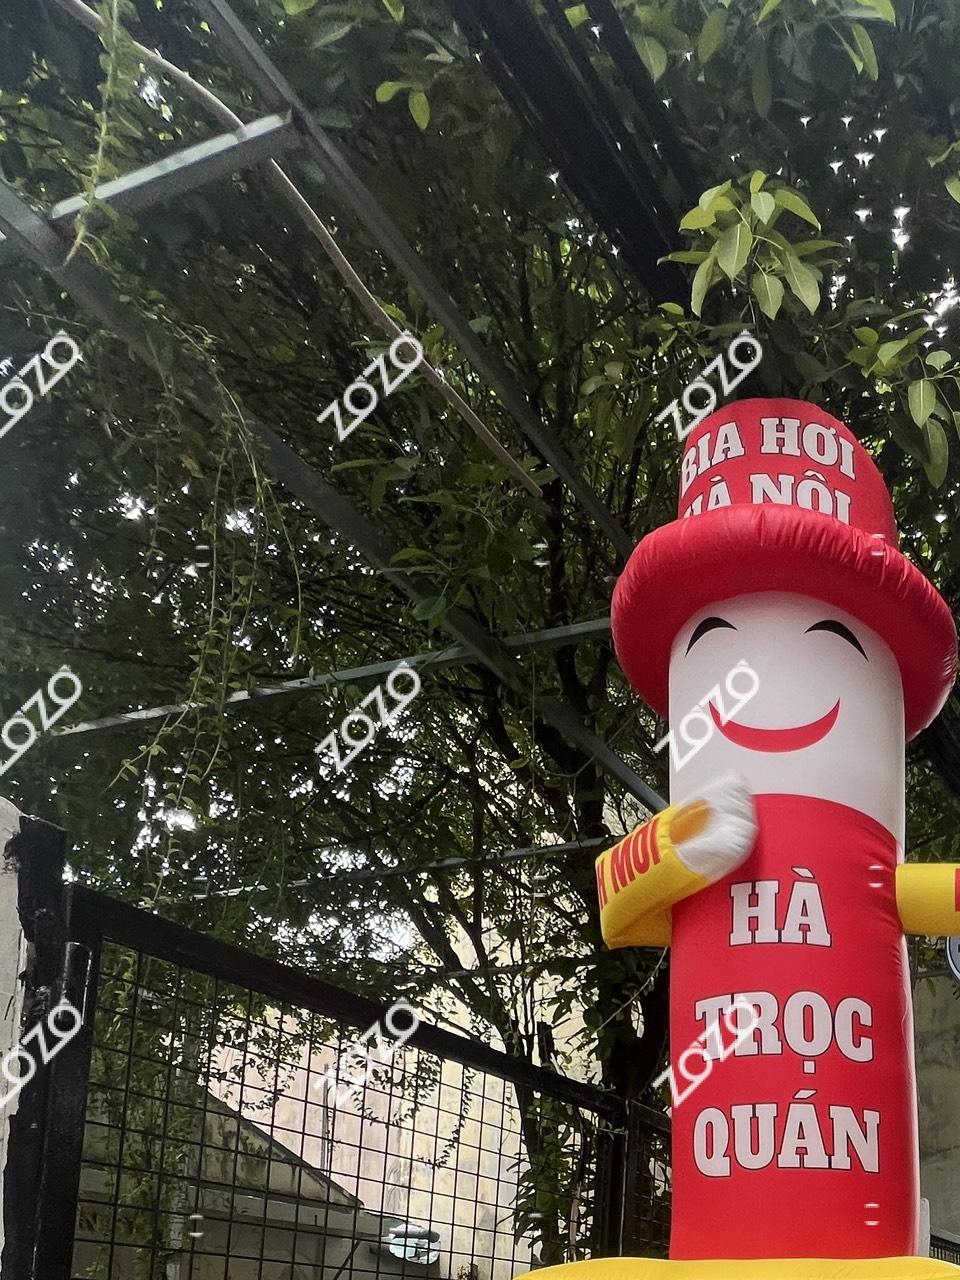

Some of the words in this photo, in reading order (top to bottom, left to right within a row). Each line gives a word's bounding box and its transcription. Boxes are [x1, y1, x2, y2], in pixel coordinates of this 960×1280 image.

[681, 421, 745, 498] BIA
[760, 417, 856, 481] HƠI
[728, 866, 832, 947] HÀ
[695, 991, 874, 1074] TRỌC
[693, 1090, 881, 1178] QUÁN
